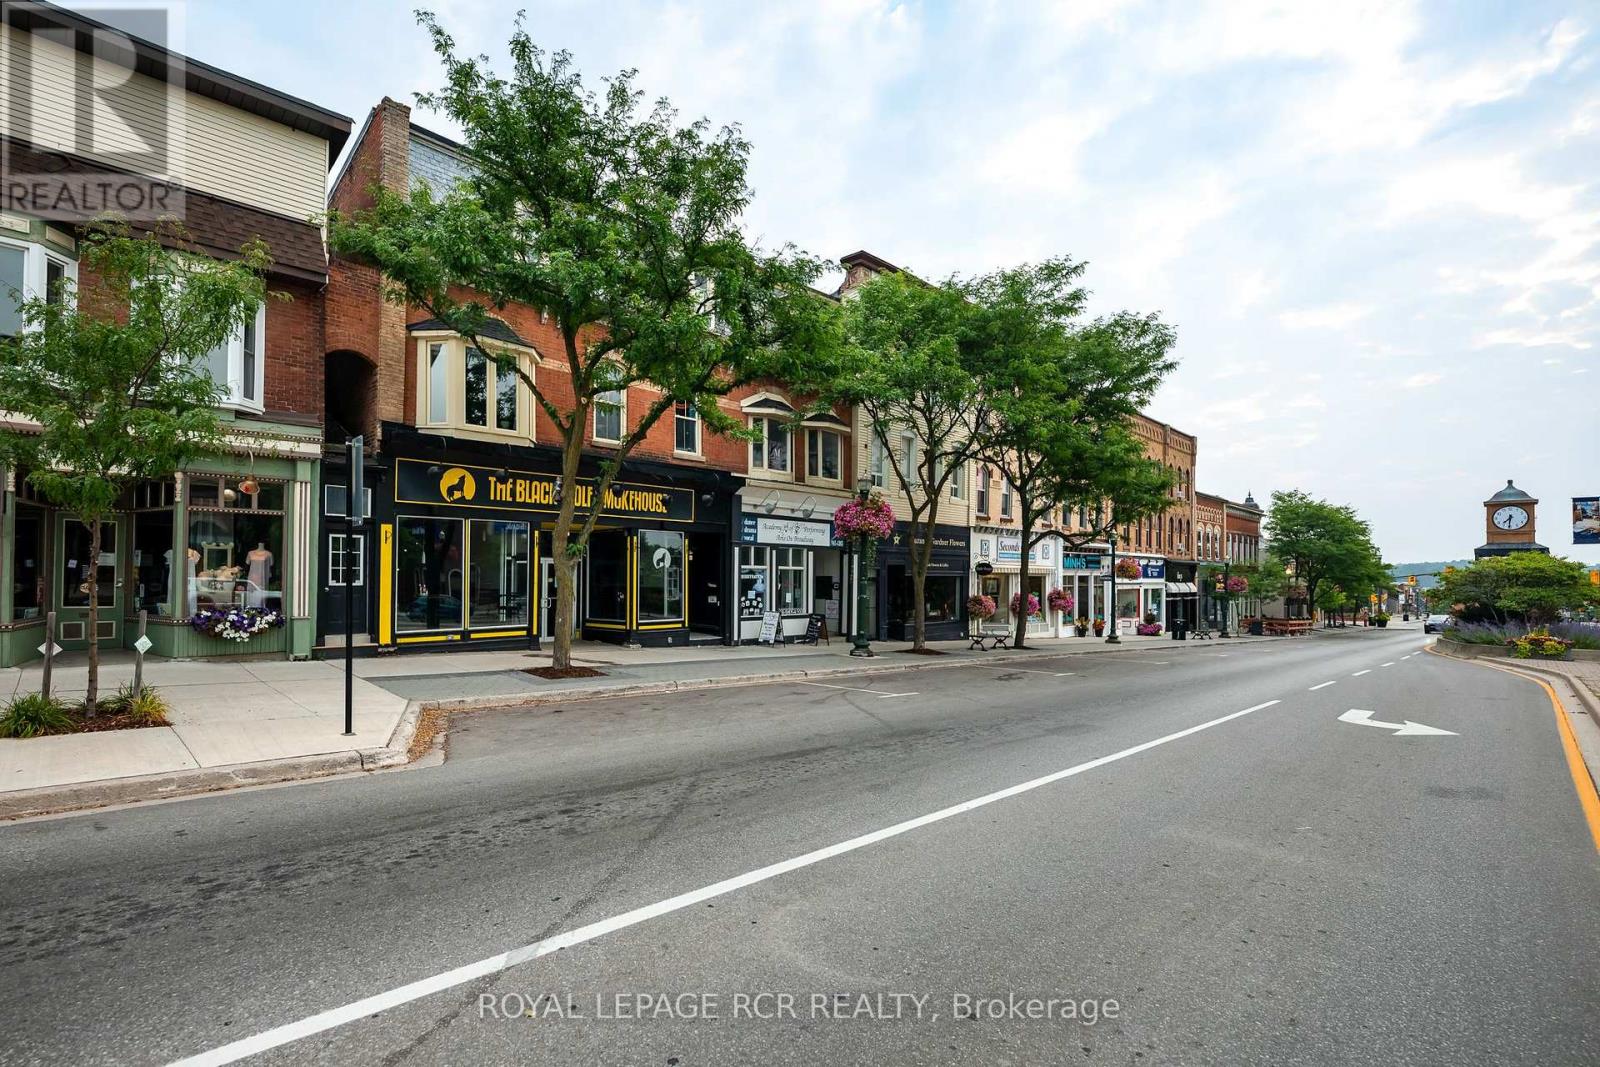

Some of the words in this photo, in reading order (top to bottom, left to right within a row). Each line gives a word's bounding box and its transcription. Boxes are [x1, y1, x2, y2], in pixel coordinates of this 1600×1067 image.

[488, 476, 513, 502] THE
[574, 485, 593, 508] OLF
[603, 488, 668, 513] MOKEHOUS
